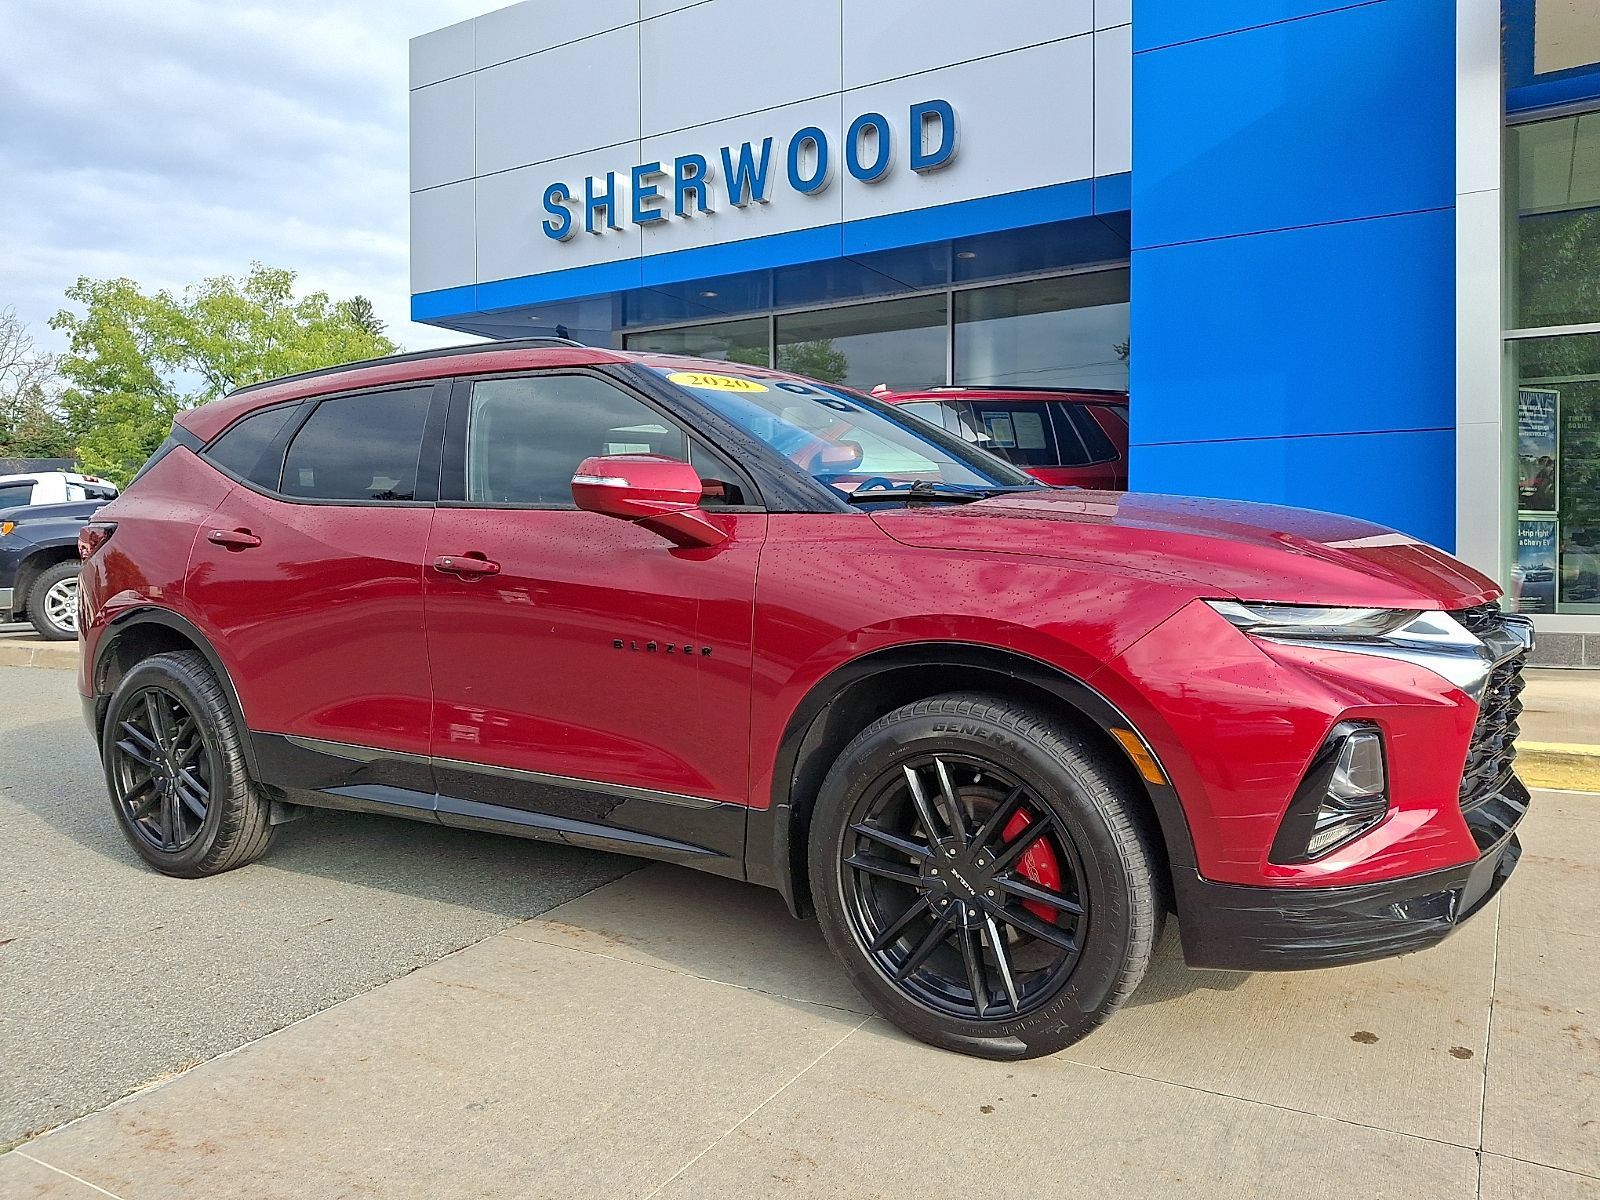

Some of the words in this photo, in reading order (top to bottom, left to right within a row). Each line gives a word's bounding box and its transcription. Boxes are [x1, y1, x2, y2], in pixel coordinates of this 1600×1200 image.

[541, 98, 960, 242] SHERWOOD
[686, 375, 750, 389] 2020
[1534, 529, 1550, 538] right
[1523, 538, 1542, 548] Chevy
[613, 638, 713, 657] BLAZER
